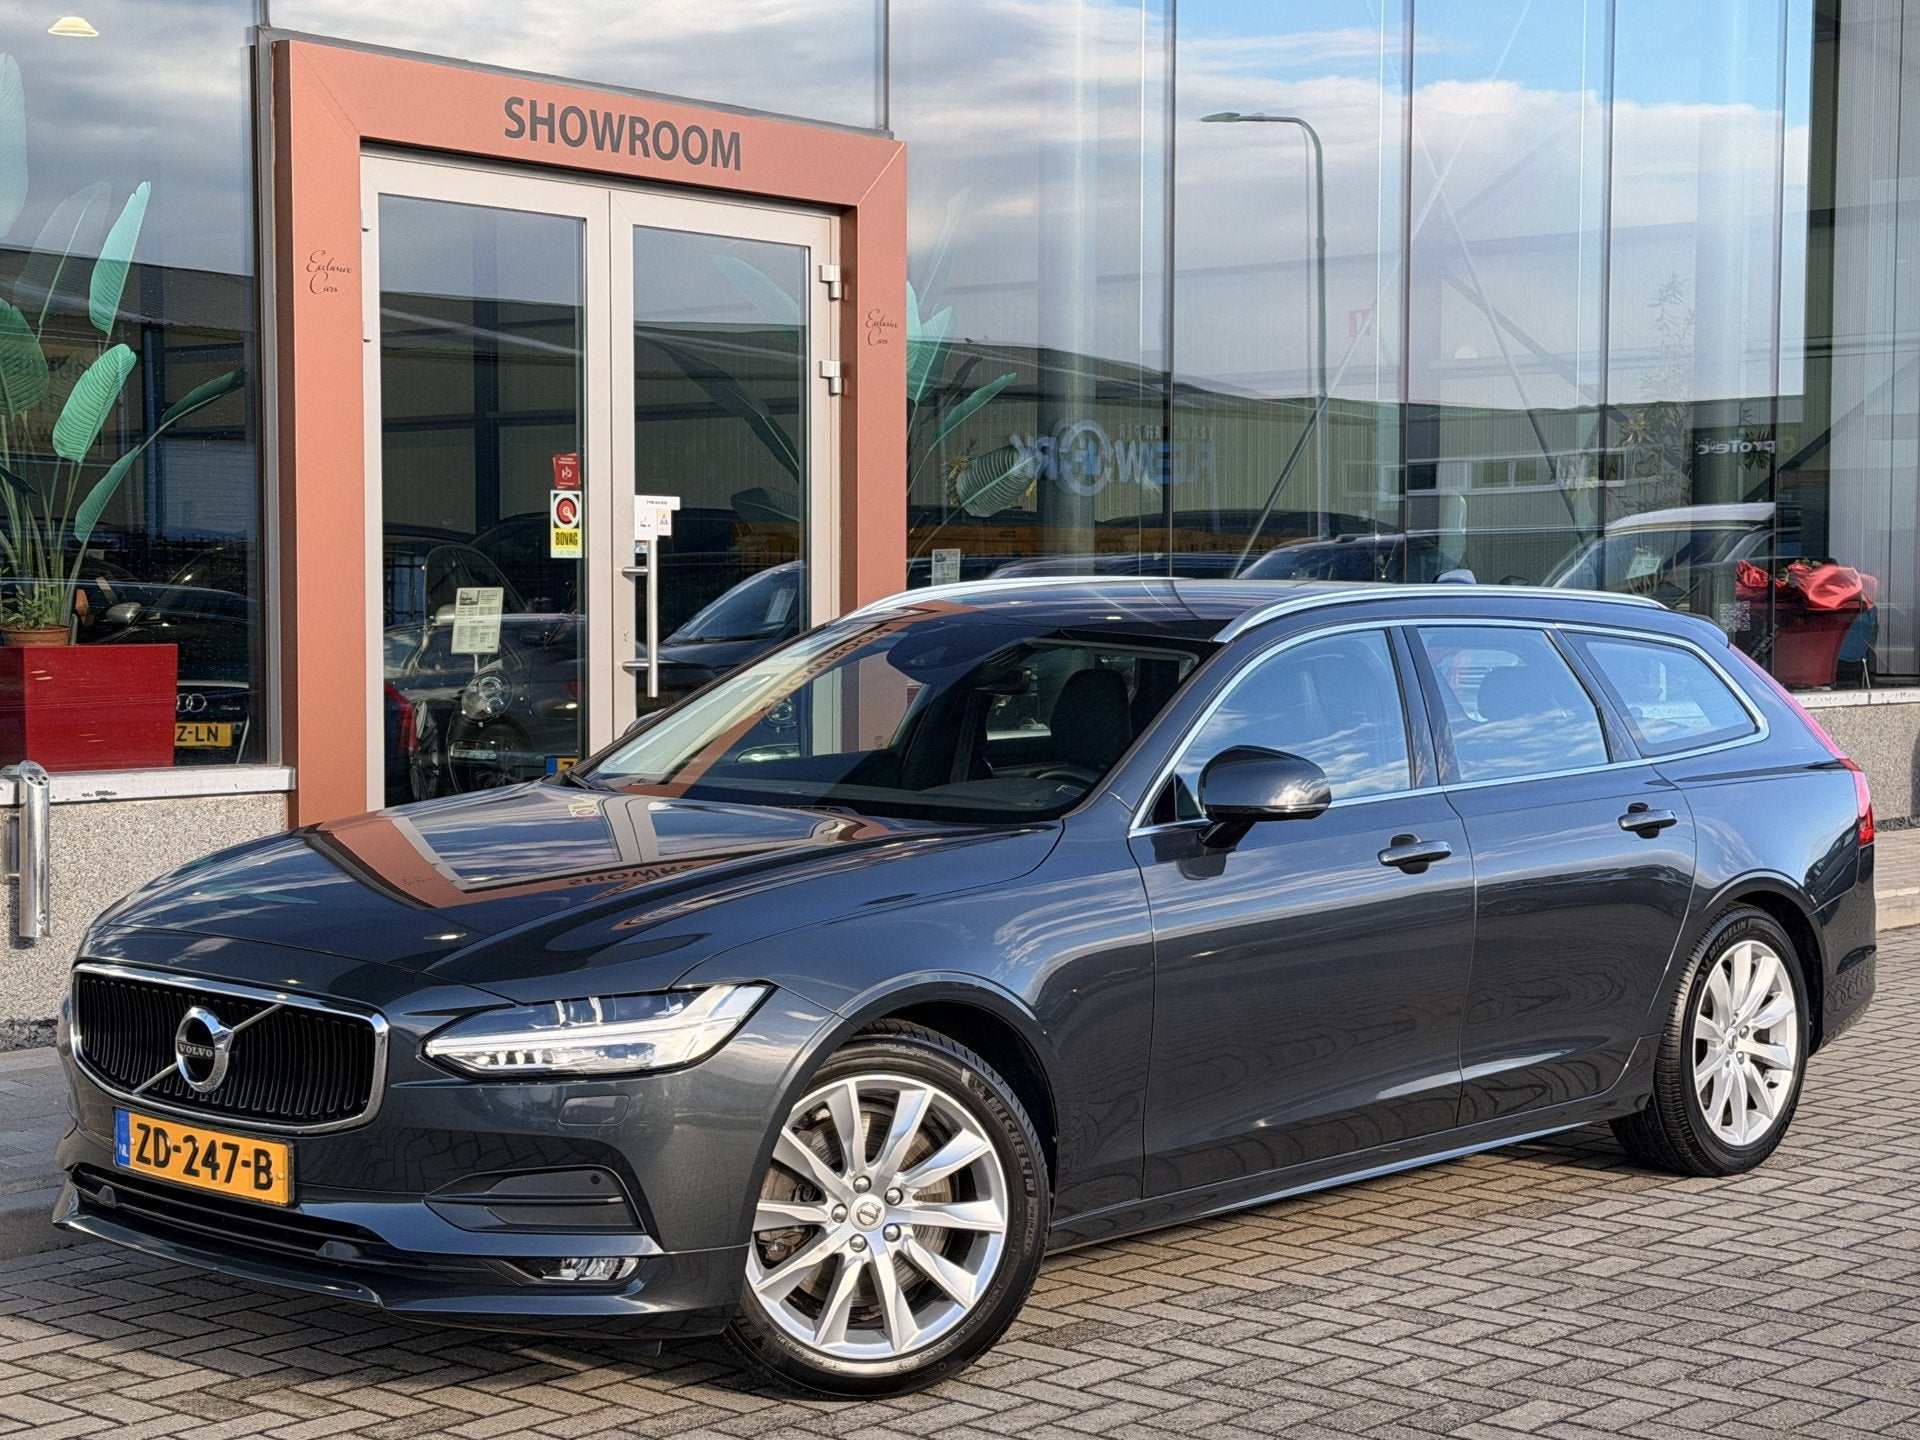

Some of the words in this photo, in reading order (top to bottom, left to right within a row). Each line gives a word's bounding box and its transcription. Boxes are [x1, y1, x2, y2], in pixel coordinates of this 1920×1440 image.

[504, 96, 742, 171] SHOWROOM
[306, 249, 352, 274] Exclusive
[309, 271, 338, 294] Cars
[865, 308, 898, 328] Exclusive
[867, 326, 888, 346] Cars
[555, 531, 578, 546] BOVAG
[1709, 921, 1747, 960] MICHELIN
[178, 1043, 214, 1058] VOLVO
[135, 1122, 274, 1191] ZD-247-B
[988, 1096, 1036, 1194] MICHELIN
[1025, 1206, 1035, 1248] PRIMACY
